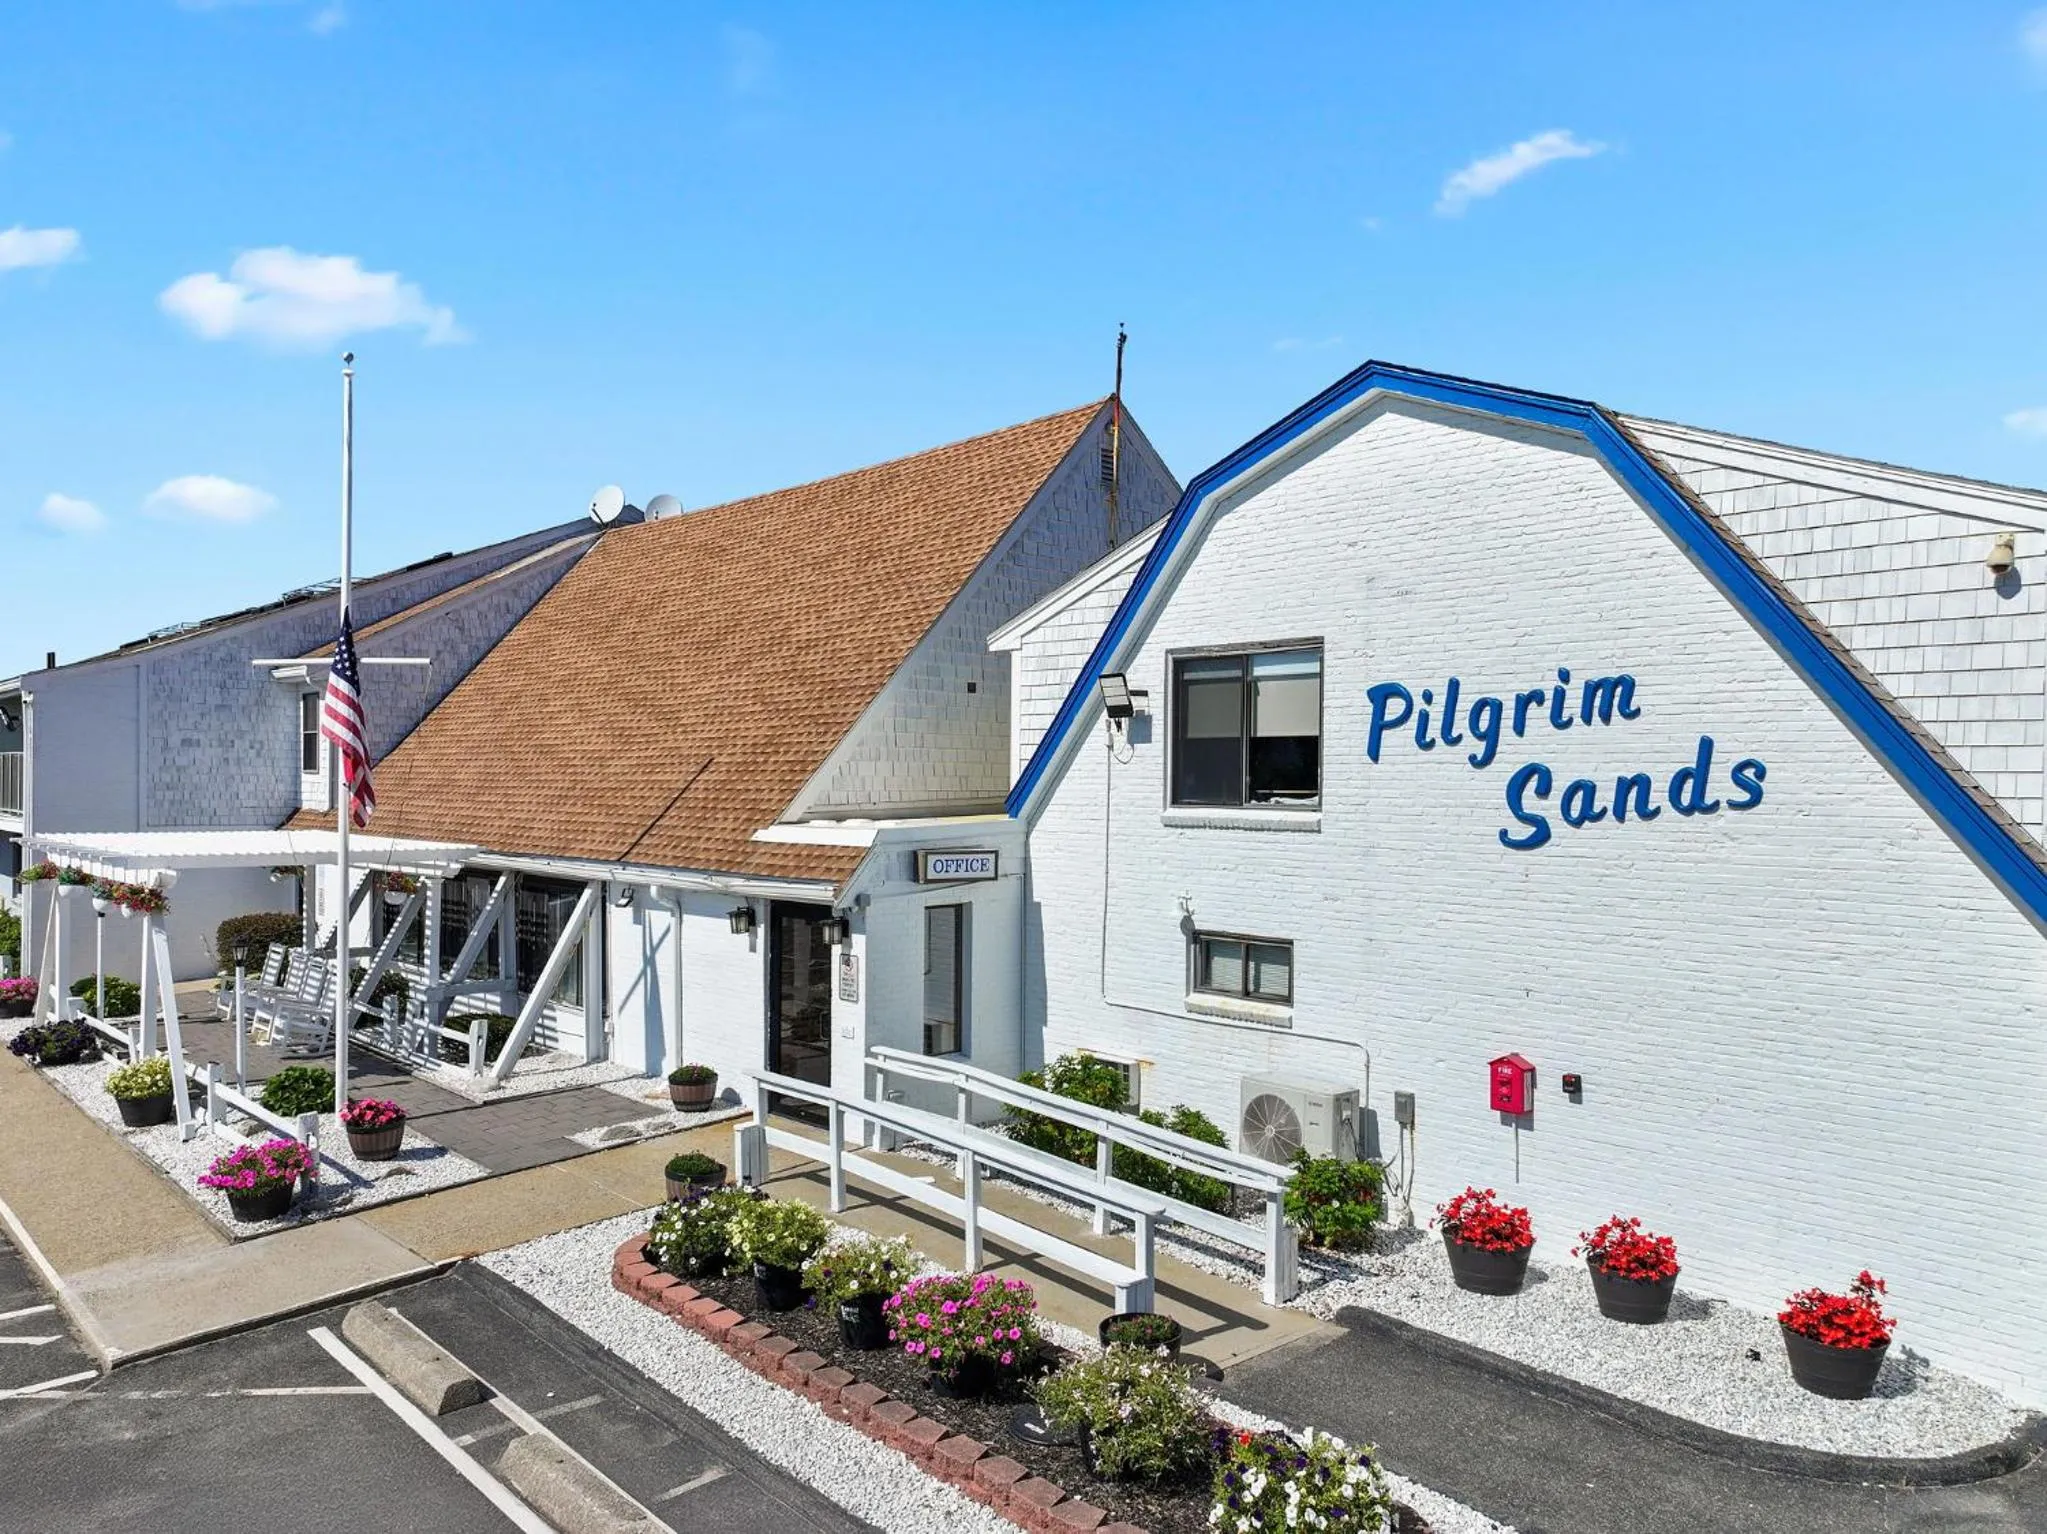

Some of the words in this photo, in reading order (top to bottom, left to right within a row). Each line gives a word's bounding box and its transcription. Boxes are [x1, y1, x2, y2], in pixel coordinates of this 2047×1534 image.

[1366, 667, 1642, 770] Pilgrim
[1499, 735, 1767, 851] Sands
[933, 858, 990, 873] OFFICE
